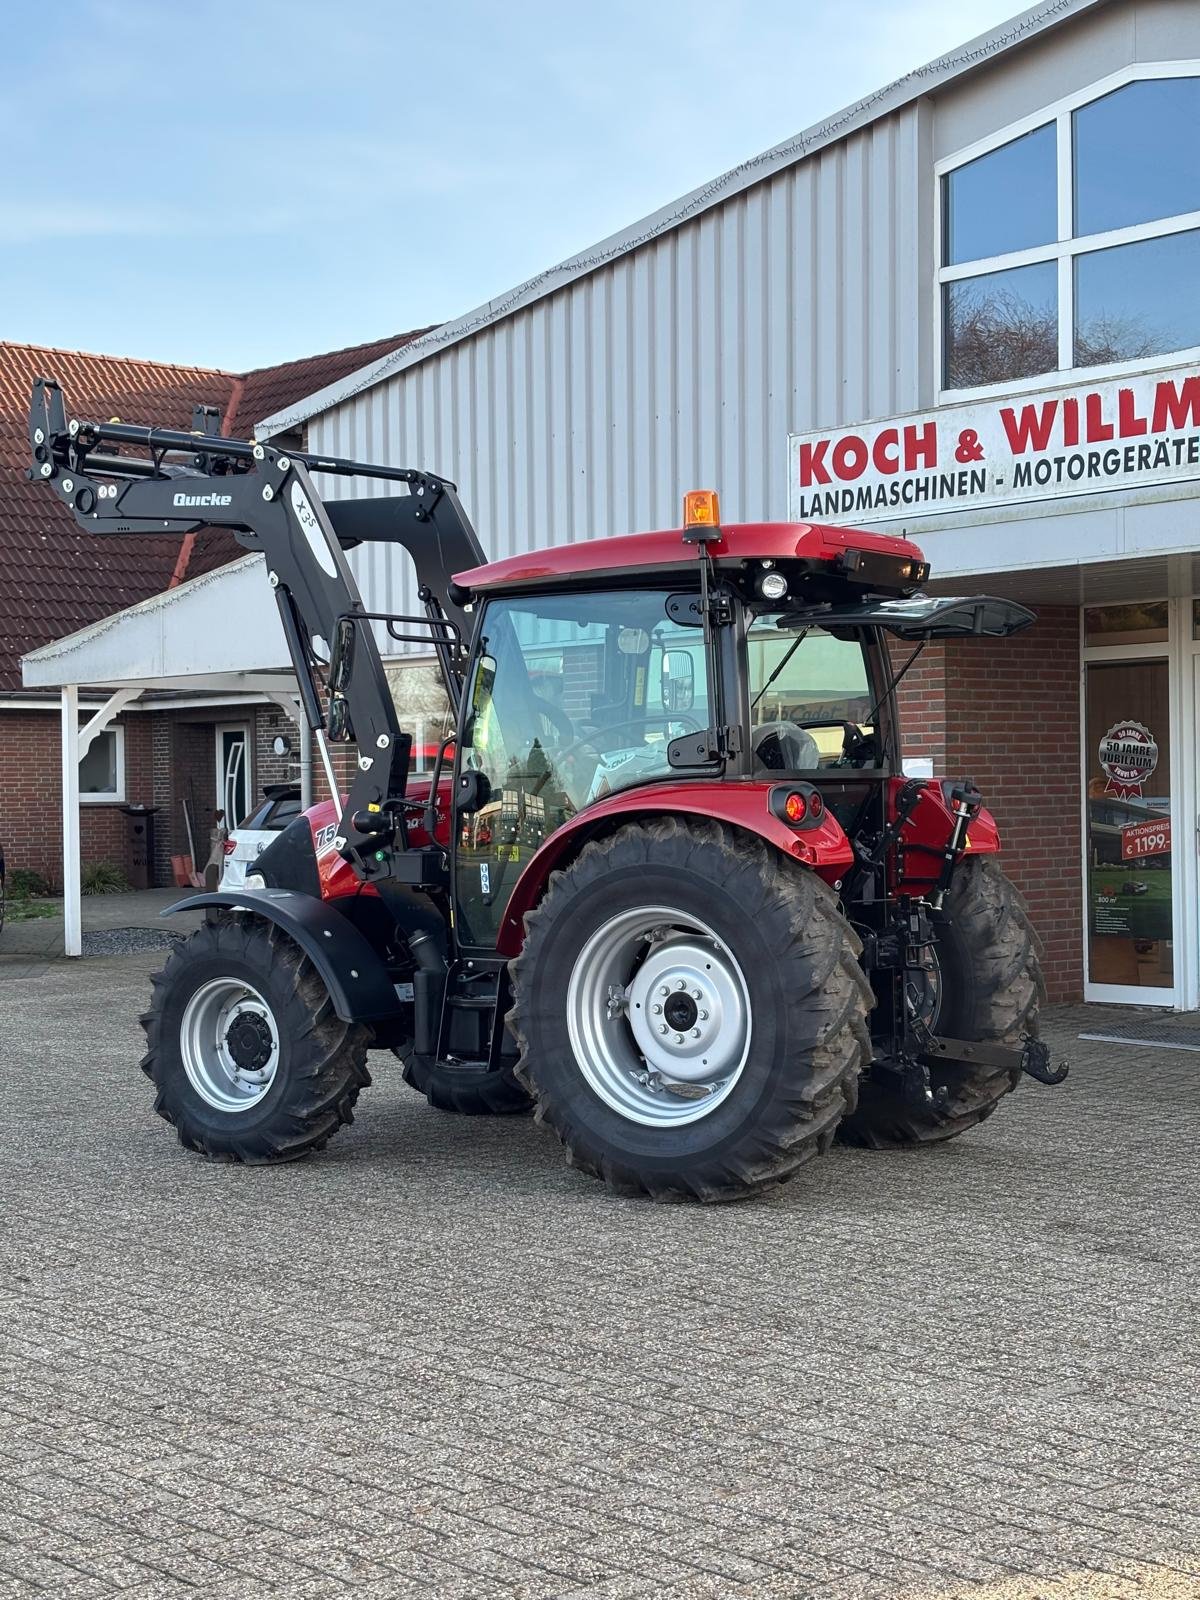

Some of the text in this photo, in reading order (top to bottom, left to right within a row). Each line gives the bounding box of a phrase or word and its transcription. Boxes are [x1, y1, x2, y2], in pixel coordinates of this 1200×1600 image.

[800, 377, 1200, 487] KOCH & WILLM
[800, 468, 987, 519] LANDMASCHINEN
[1013, 436, 1200, 488] MOTORGERÄTE
[173, 492, 232, 507] Quicke
[1106, 741, 1152, 756] 50 JAHRE
[1126, 823, 1170, 837] AKTIONSPREIS
[1126, 845, 1133, 855] €
